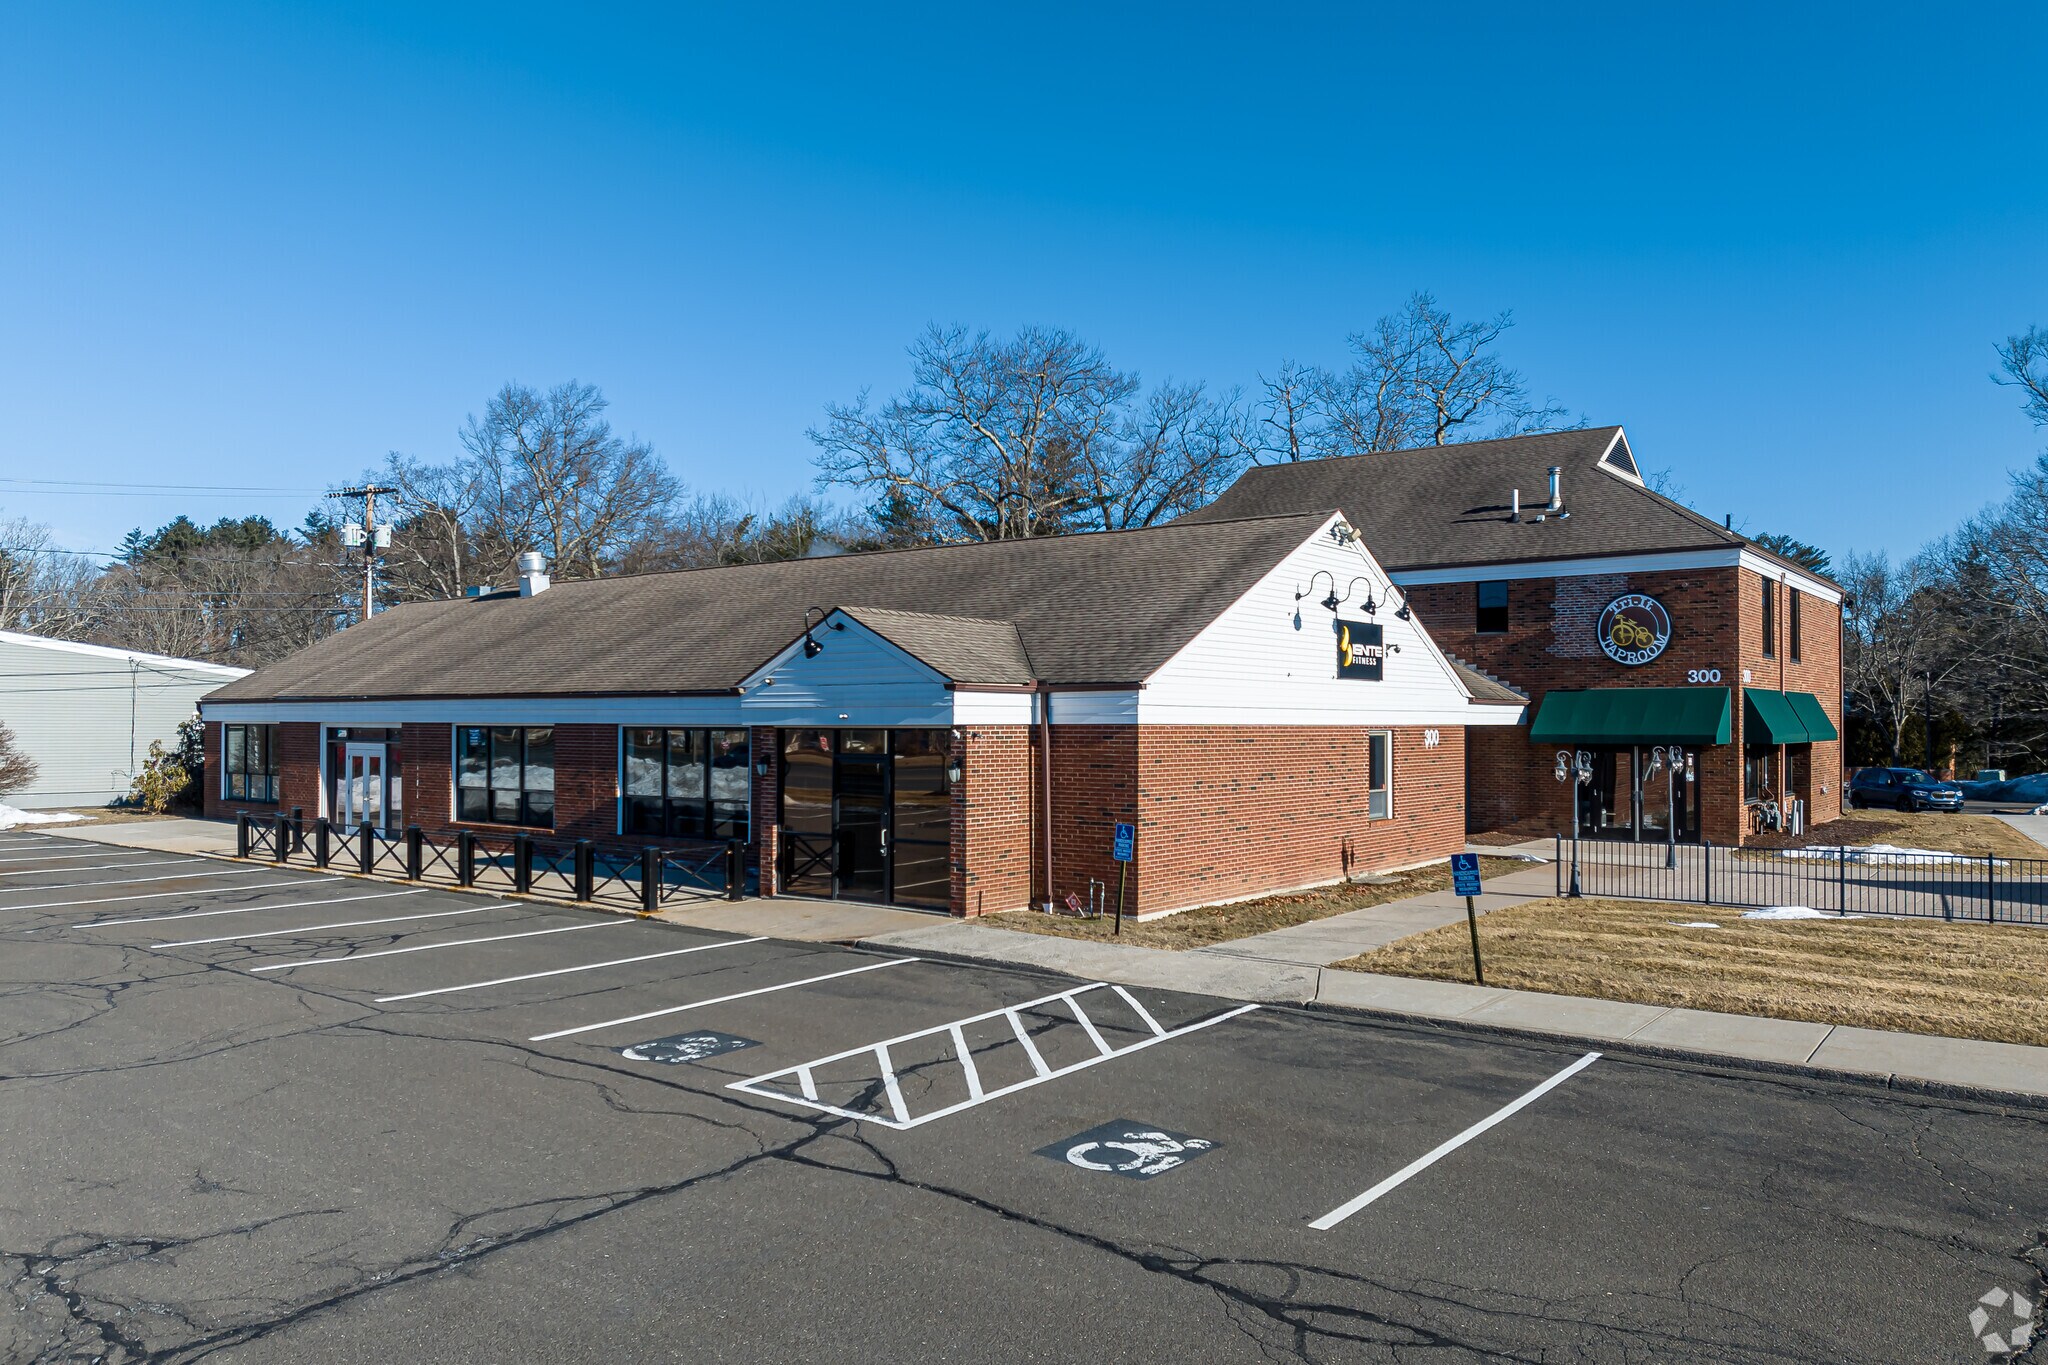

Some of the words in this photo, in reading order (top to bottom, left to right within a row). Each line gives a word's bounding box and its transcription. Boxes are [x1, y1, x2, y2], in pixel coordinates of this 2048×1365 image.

[1608, 596, 1653, 615] Tri-It
[1605, 632, 1667, 662] TAPROOM
[1352, 656, 1377, 666] FITNESS
[1687, 669, 1721, 683] 300
[1424, 729, 1440, 747] 300
